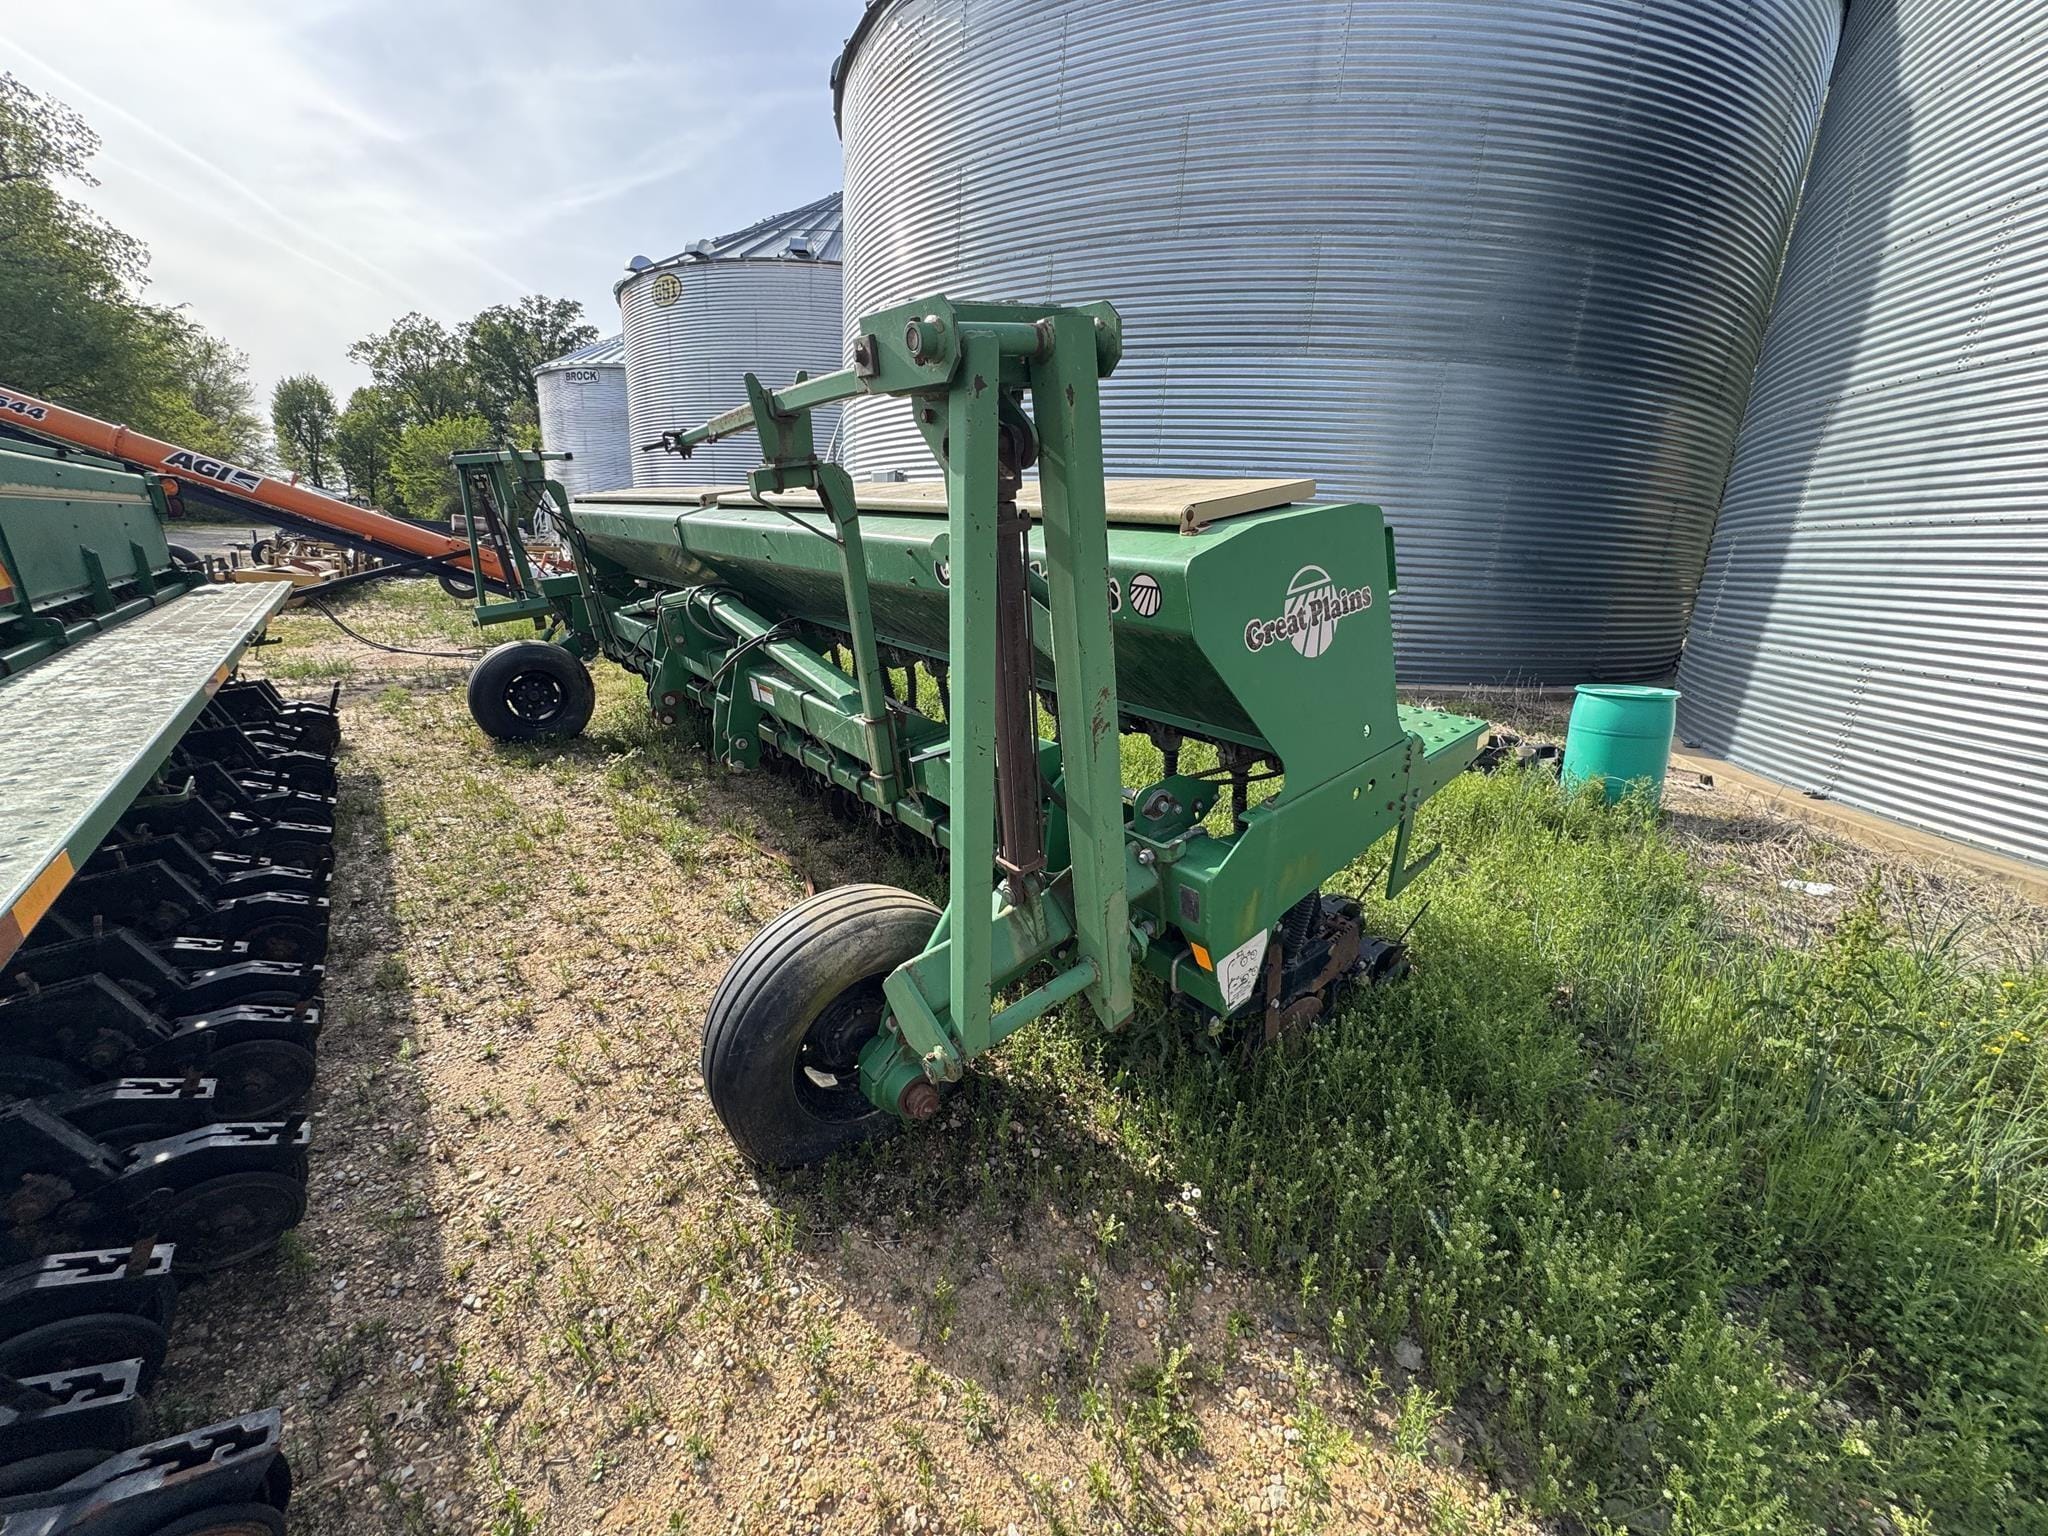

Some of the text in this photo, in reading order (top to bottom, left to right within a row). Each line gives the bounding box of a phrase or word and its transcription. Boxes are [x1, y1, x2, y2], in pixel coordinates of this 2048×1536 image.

[565, 370, 598, 381] BROCK
[166, 452, 232, 481] AGI
[1245, 586, 1371, 651] Great Plains
